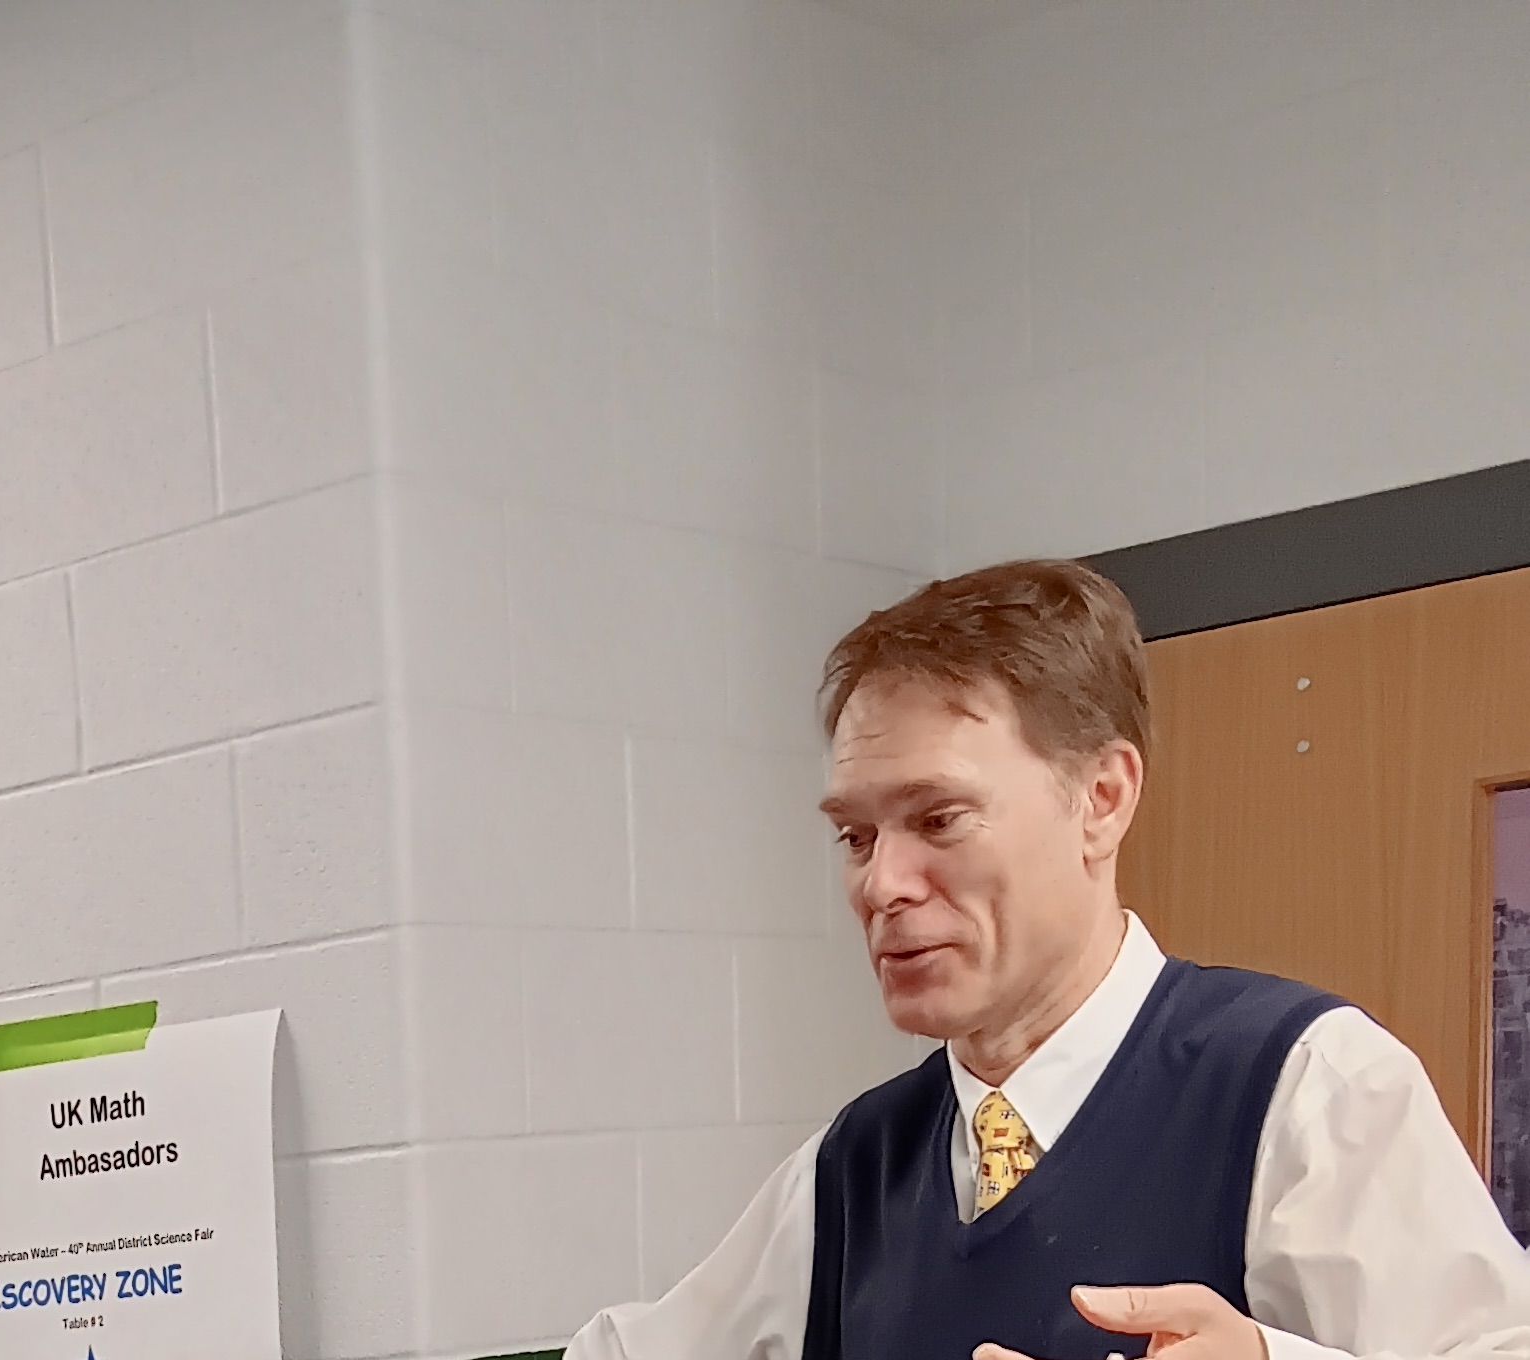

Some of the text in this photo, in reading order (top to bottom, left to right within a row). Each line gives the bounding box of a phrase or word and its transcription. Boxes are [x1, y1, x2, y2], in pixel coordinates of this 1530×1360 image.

[50, 1090, 145, 1129] UK Math
[40, 1140, 179, 1181] Ambasadors
[30, 1247, 60, 1260] Water
[86, 1239, 116, 1253] Annual
[118, 1234, 153, 1250] District
[154, 1230, 193, 1246] Science
[194, 1227, 215, 1241] Fair
[115, 1263, 183, 1299] ZONE
[62, 1317, 89, 1331] Table
